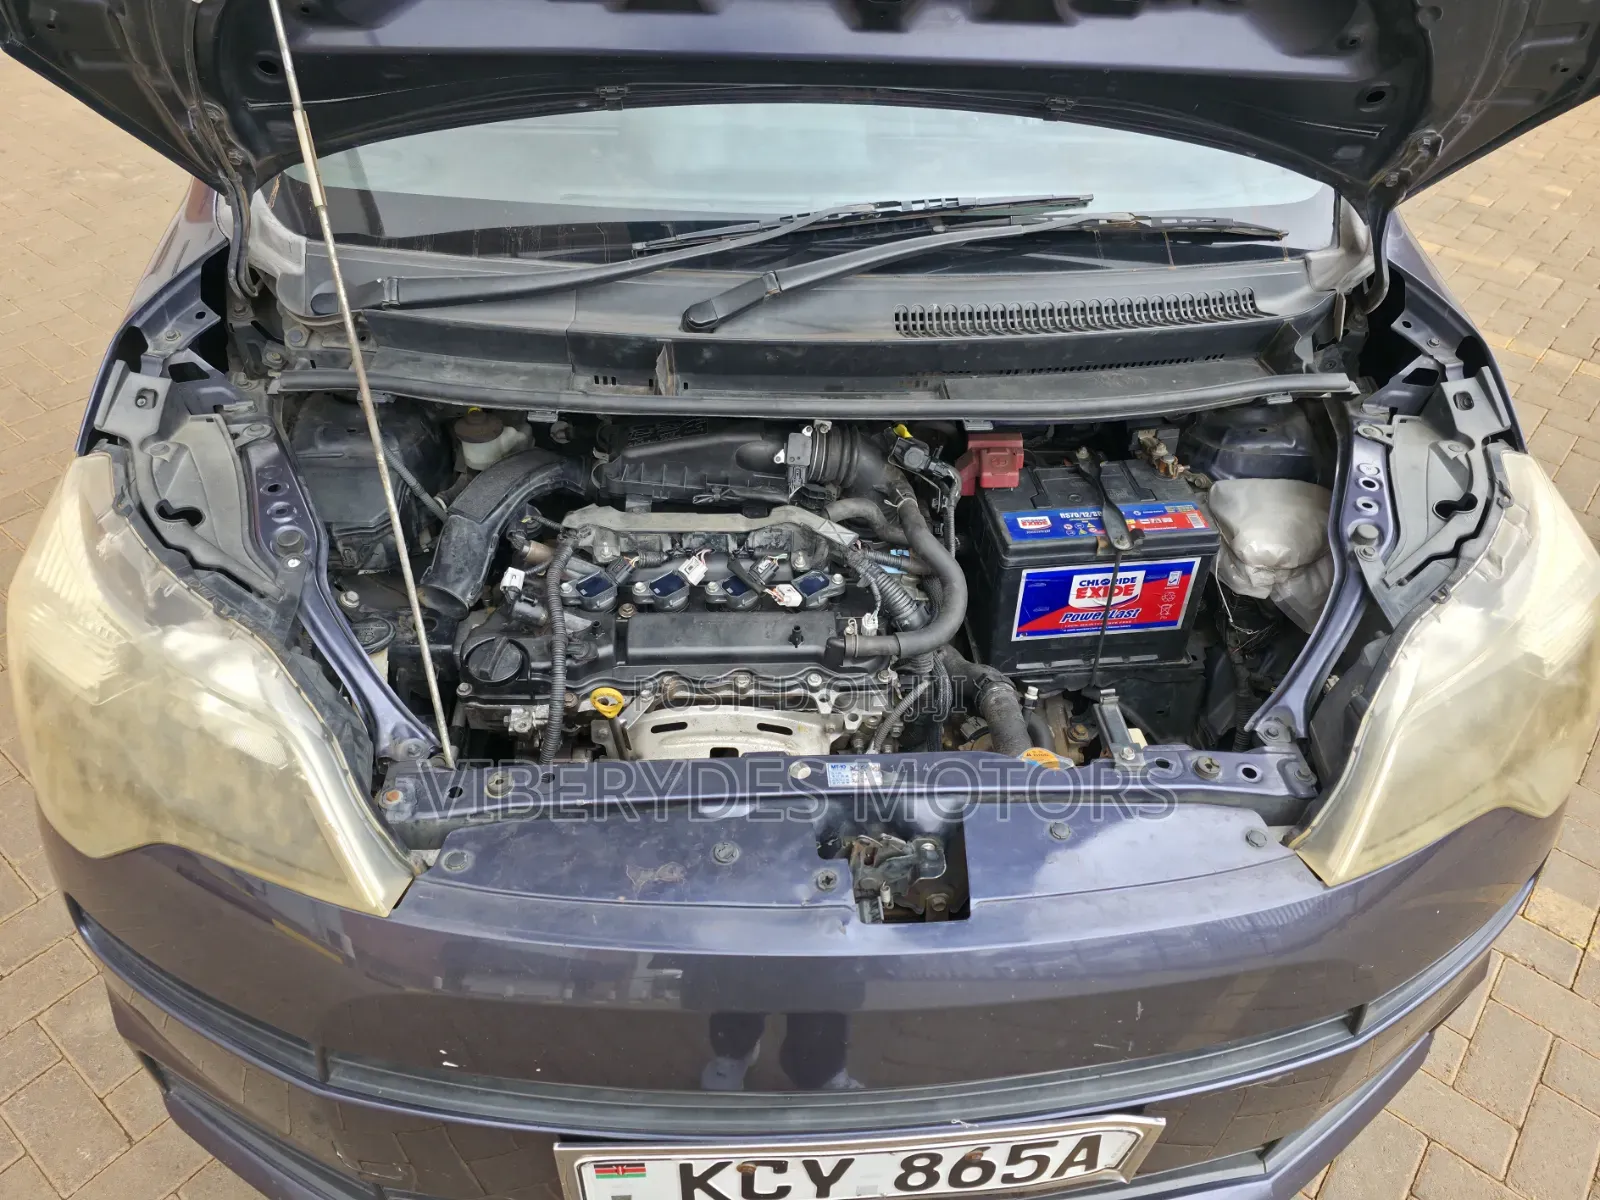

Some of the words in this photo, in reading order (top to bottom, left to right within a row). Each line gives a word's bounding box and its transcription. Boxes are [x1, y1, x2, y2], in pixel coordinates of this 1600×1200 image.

[1075, 583, 1137, 600] EXIDE
[679, 1157, 855, 1200] KCY
[893, 1134, 1102, 1192] 865A
